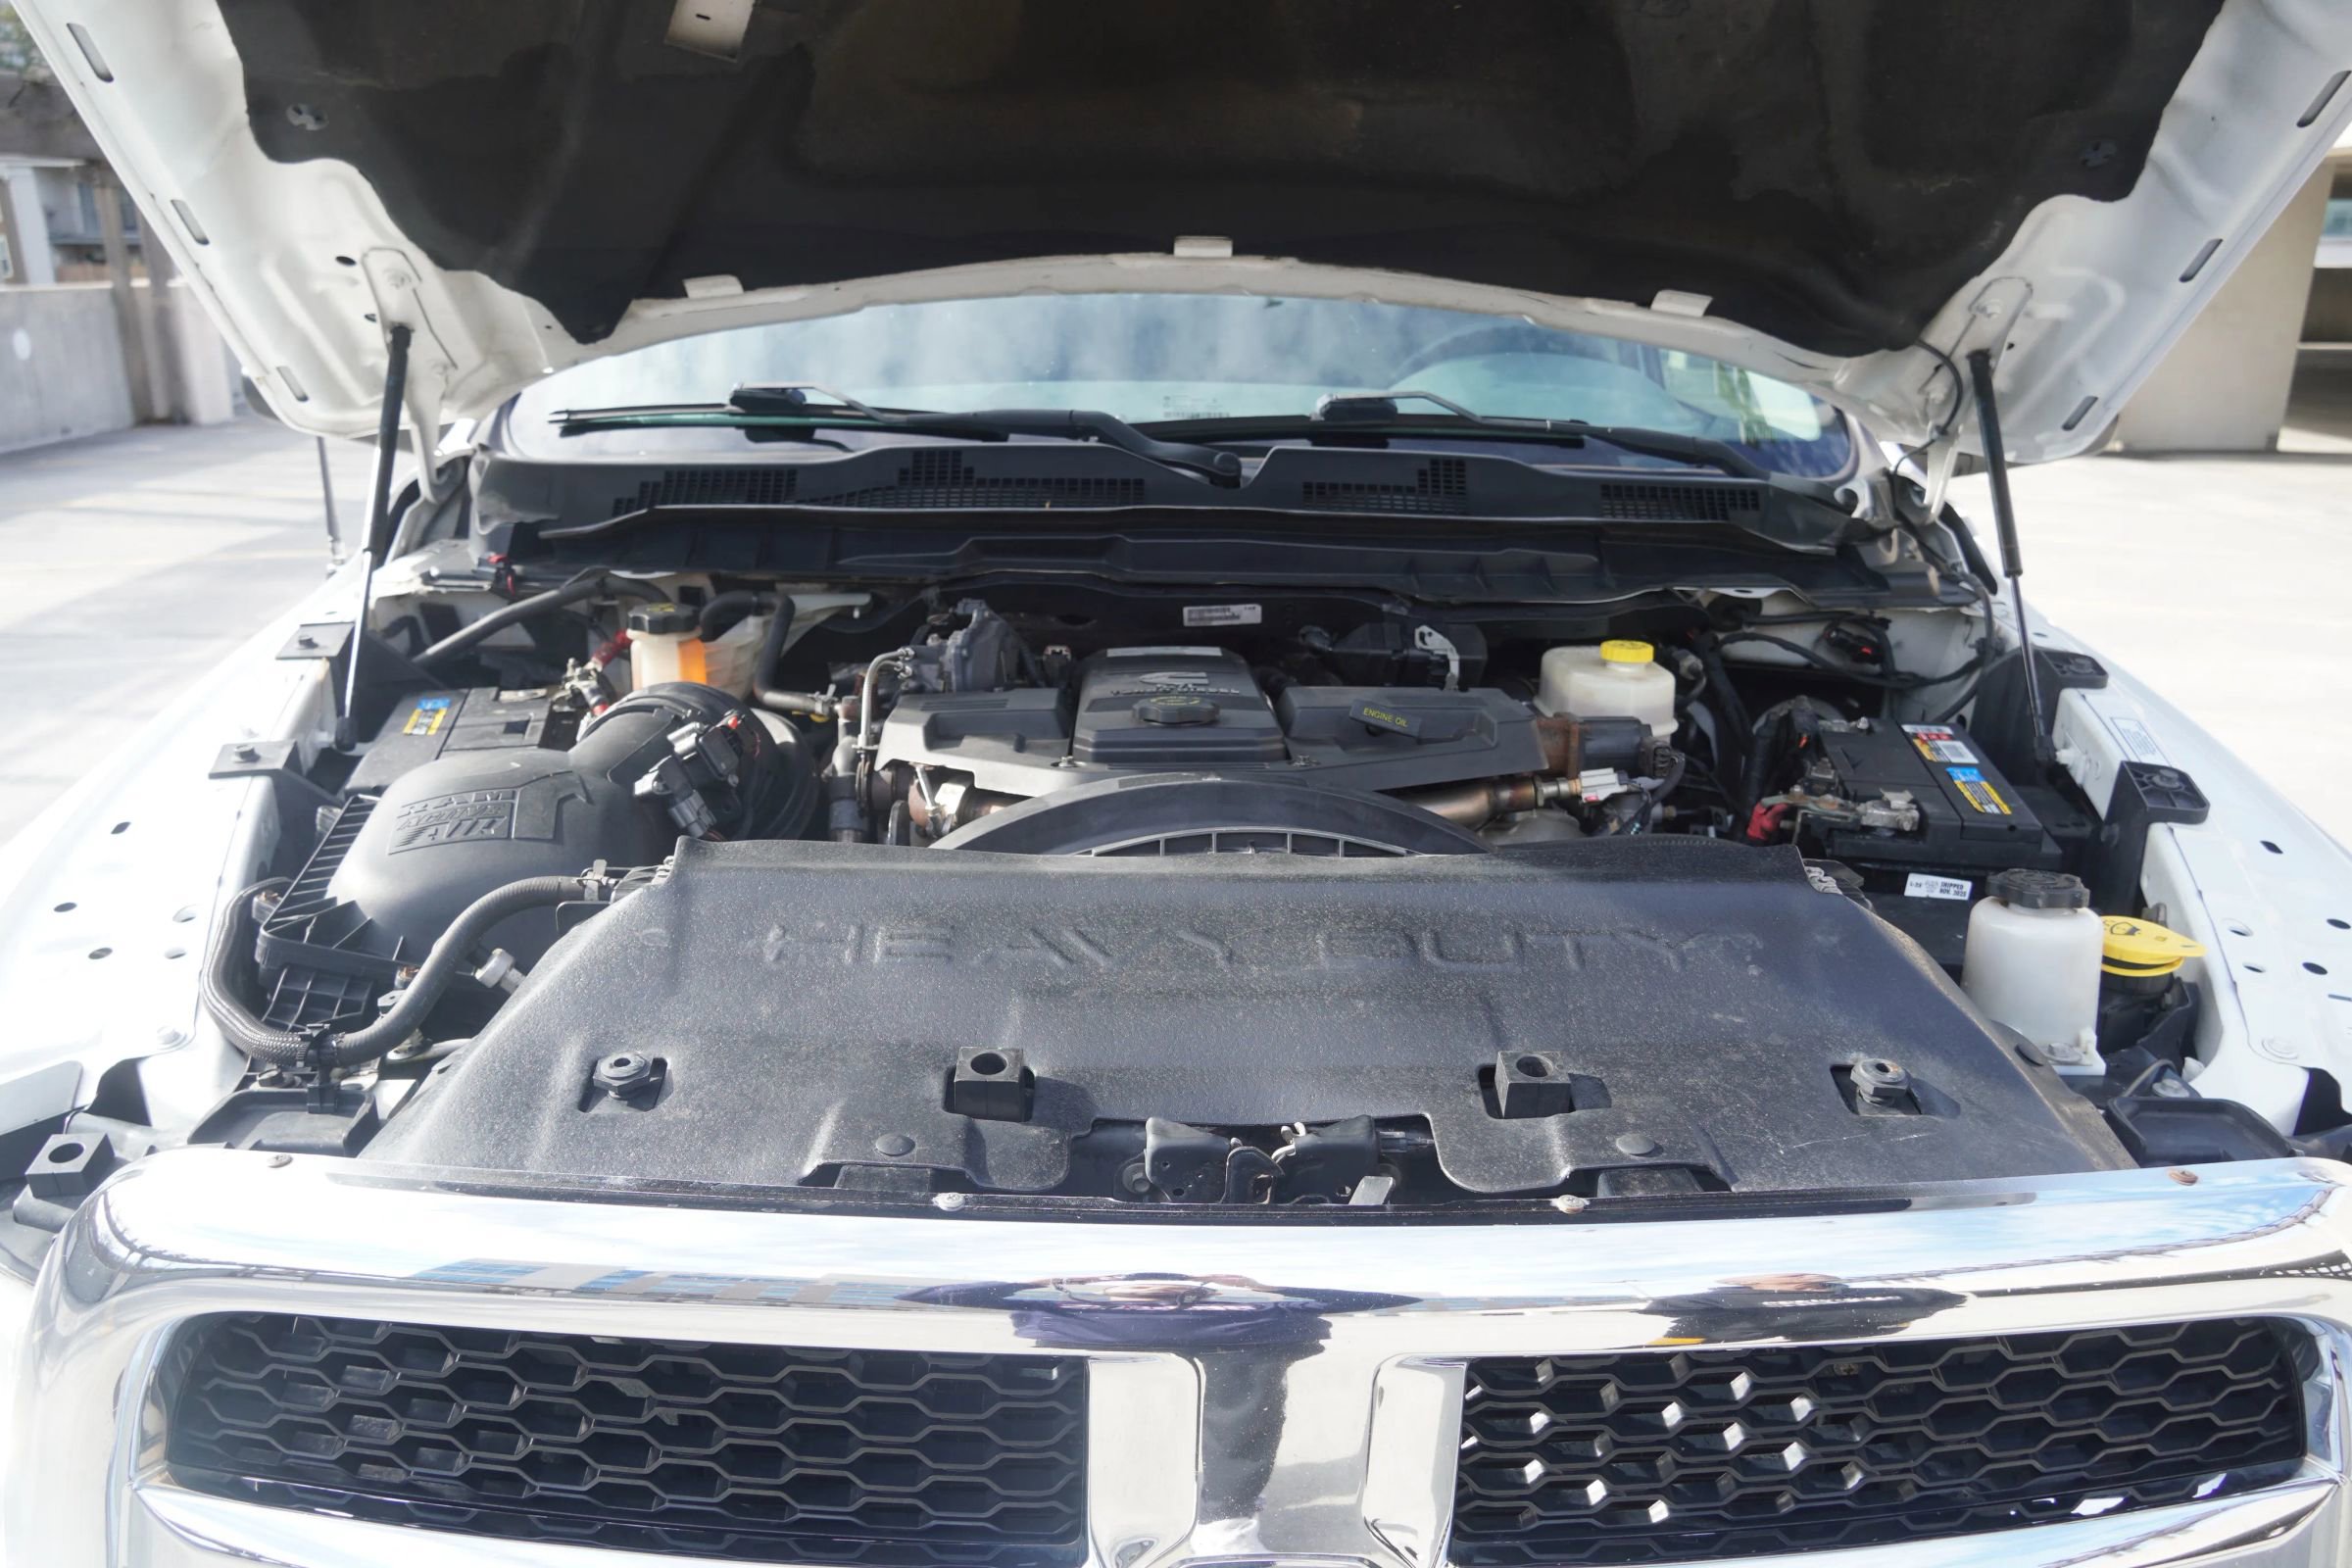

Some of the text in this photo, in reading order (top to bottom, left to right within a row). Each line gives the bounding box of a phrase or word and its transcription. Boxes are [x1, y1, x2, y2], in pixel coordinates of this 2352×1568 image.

[1362, 706, 1409, 728] ENGINE OIL
[397, 790, 513, 818] RAM
[761, 918, 1754, 972] HEAVY DUTY
